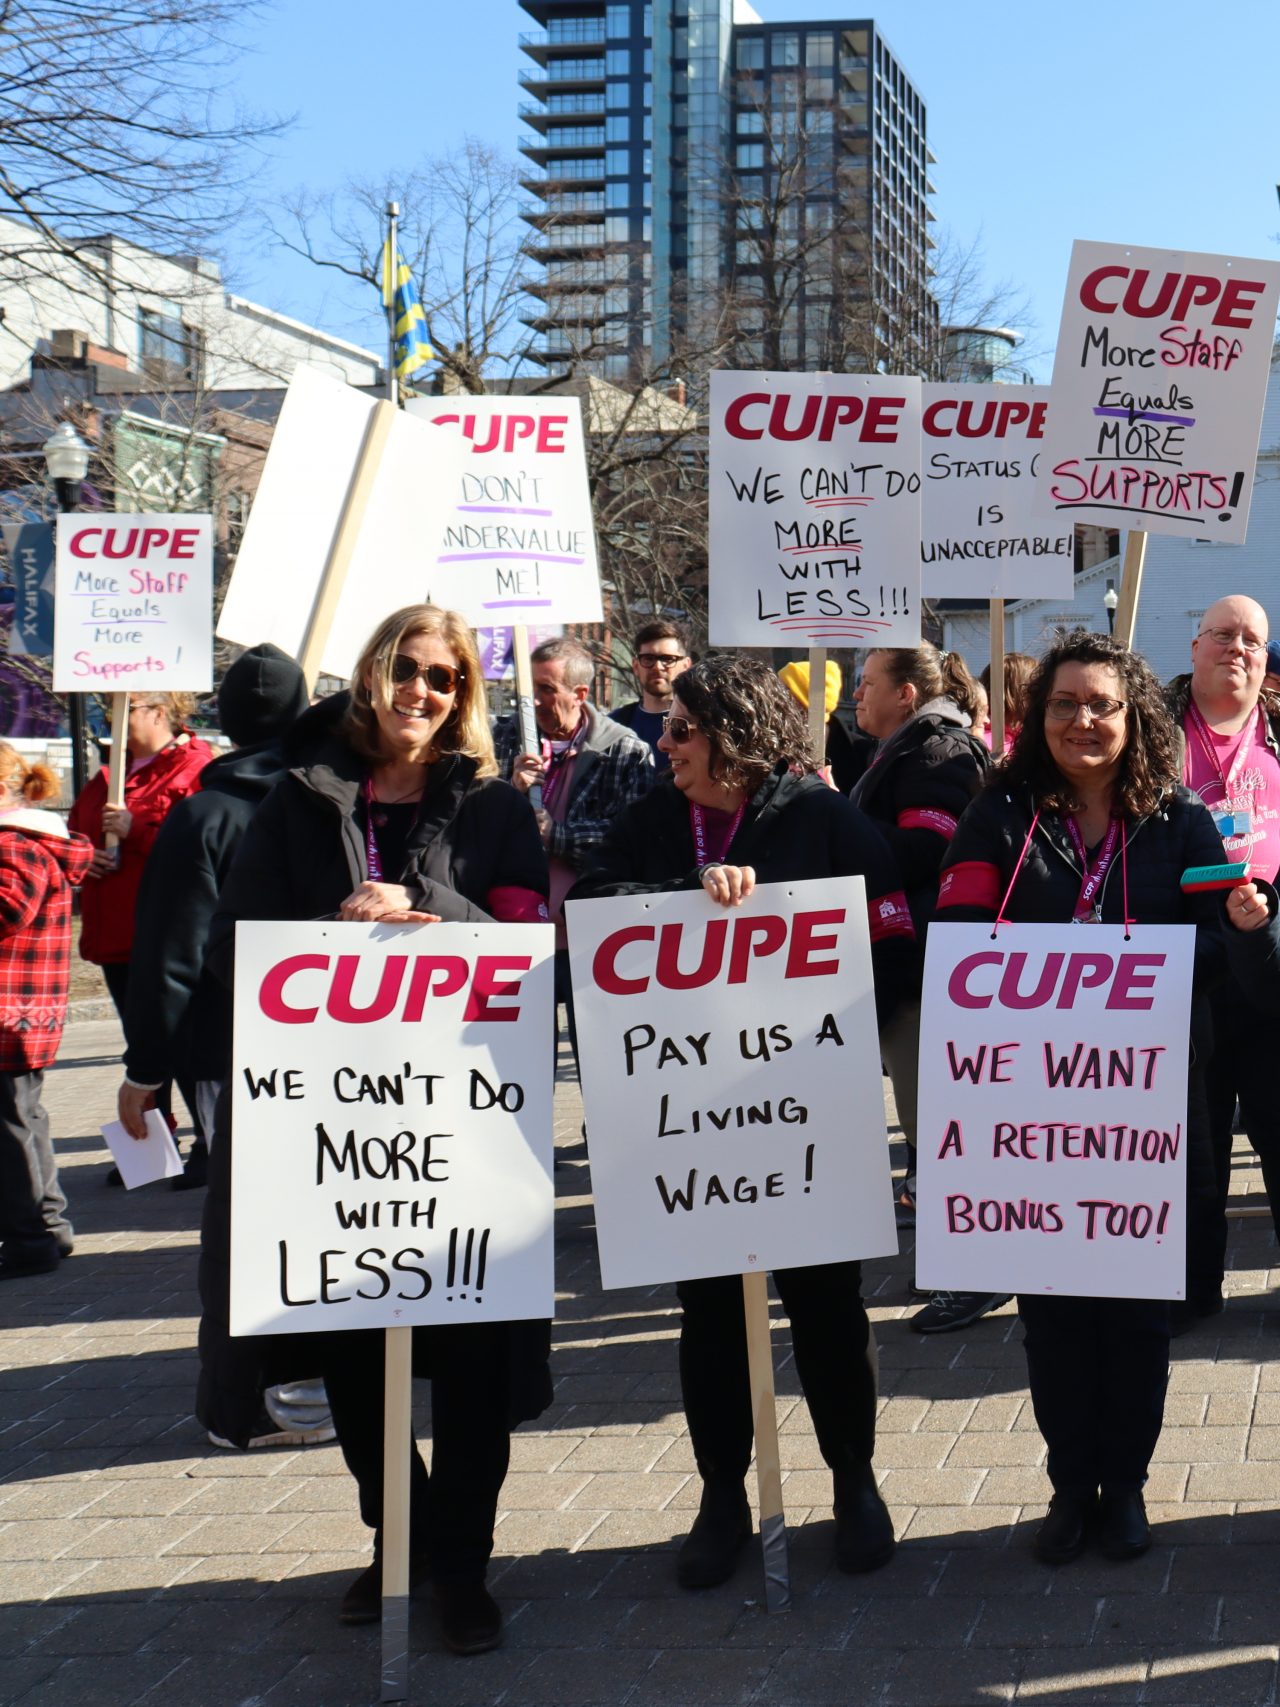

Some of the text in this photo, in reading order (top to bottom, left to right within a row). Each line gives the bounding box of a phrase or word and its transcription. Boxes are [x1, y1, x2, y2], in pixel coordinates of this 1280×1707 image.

[1079, 265, 1267, 329] CUPE
[1081, 325, 1244, 373] More Staff
[724, 392, 907, 443] CUPE
[921, 399, 1048, 439] CUPE
[1097, 376, 1194, 427] Equals
[1097, 421, 1185, 459] MORE
[461, 470, 544, 504] DON'T
[725, 463, 921, 503] WE CAN'T DO
[1050, 459, 1246, 522] SUPPORTS!
[775, 517, 863, 550] MORE
[977, 504, 1004, 526] IS
[69, 527, 200, 560] CUPE
[920, 534, 1073, 563] UNACCEPTABLE!
[74, 569, 189, 594] More Staff
[496, 561, 541, 596] ME!
[778, 557, 862, 579] WITH
[21, 548, 39, 636] HALIFAX
[90, 601, 161, 624] Equals
[758, 586, 909, 620] LESS!!!
[94, 626, 143, 646] More
[491, 628, 506, 669] LIFAX
[1083, 881, 1095, 901] SCFP
[592, 908, 847, 996] CUPE
[258, 953, 532, 1024] CUPE
[947, 952, 1166, 1010] CUPE
[623, 1013, 845, 1076] PAY US A
[946, 1041, 1167, 1091] WE WANT
[243, 1062, 524, 1113] WE CAN'T DO
[656, 1095, 809, 1138] LIVING
[314, 1122, 453, 1185] MORE
[937, 1119, 1181, 1164] A RETENTION
[335, 1196, 437, 1230] WITH
[946, 1195, 1170, 1244] BONUS TOO!
[278, 1227, 491, 1306] LESS!!!
